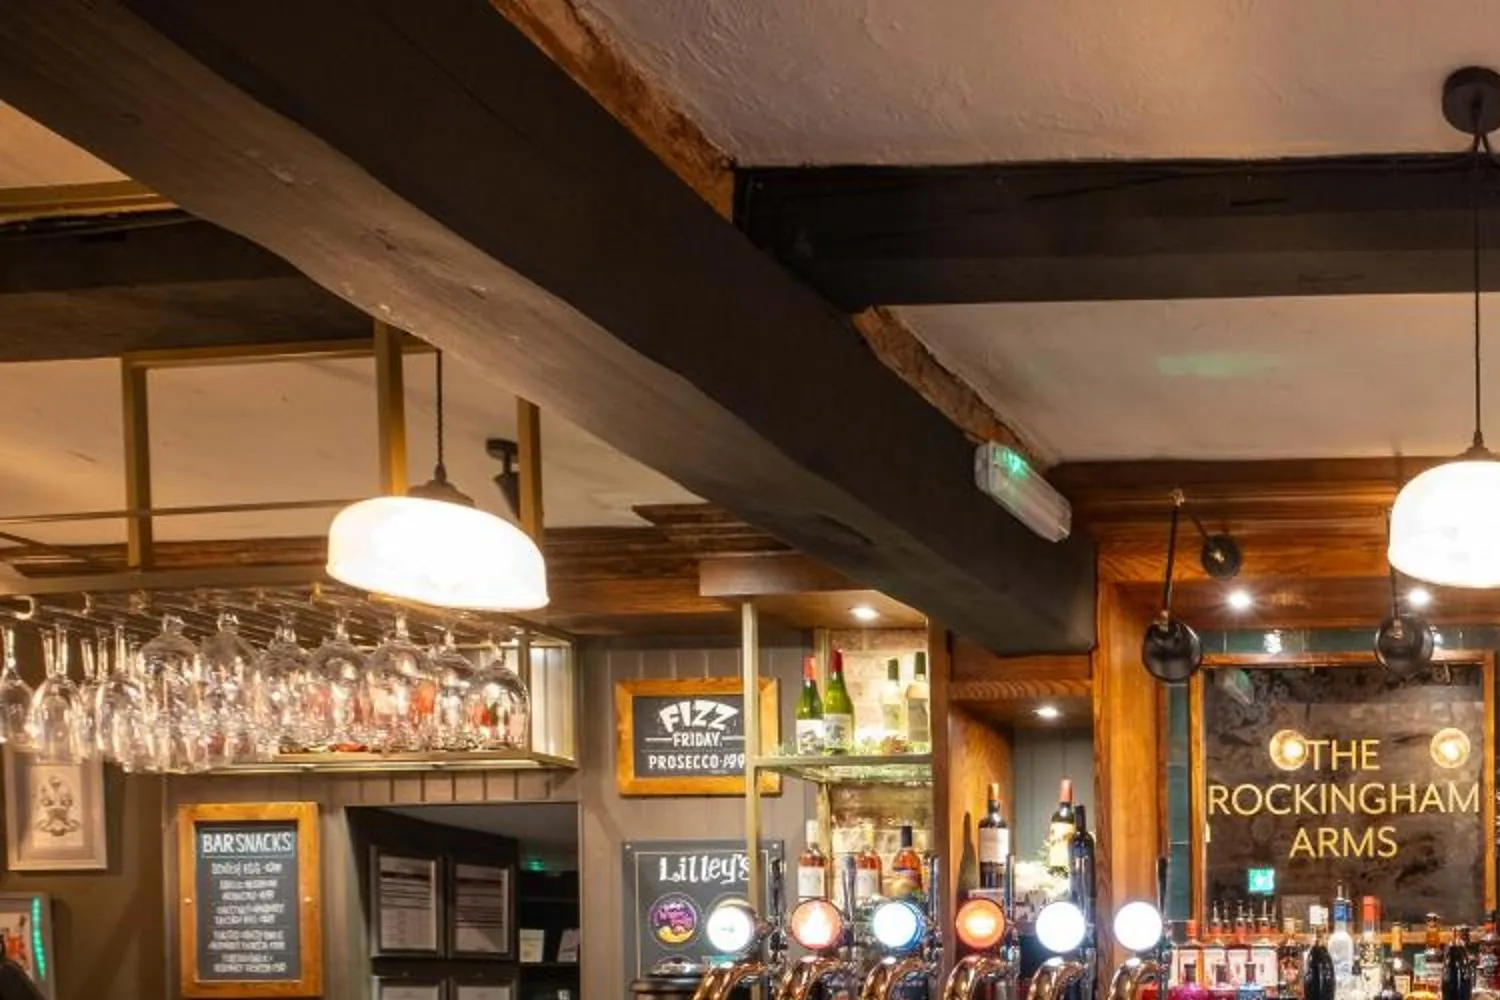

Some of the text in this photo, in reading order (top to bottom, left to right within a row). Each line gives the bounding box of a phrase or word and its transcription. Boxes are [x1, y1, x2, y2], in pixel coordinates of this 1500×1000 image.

[659, 700, 739, 732] FIZZ
[673, 732, 721, 747] FRIDAY
[1305, 740, 1380, 771] THE
[1208, 783, 1479, 815] ROCKINGHAM
[203, 832, 292, 852] BAR SNACKS
[1289, 827, 1397, 858] ARMS
